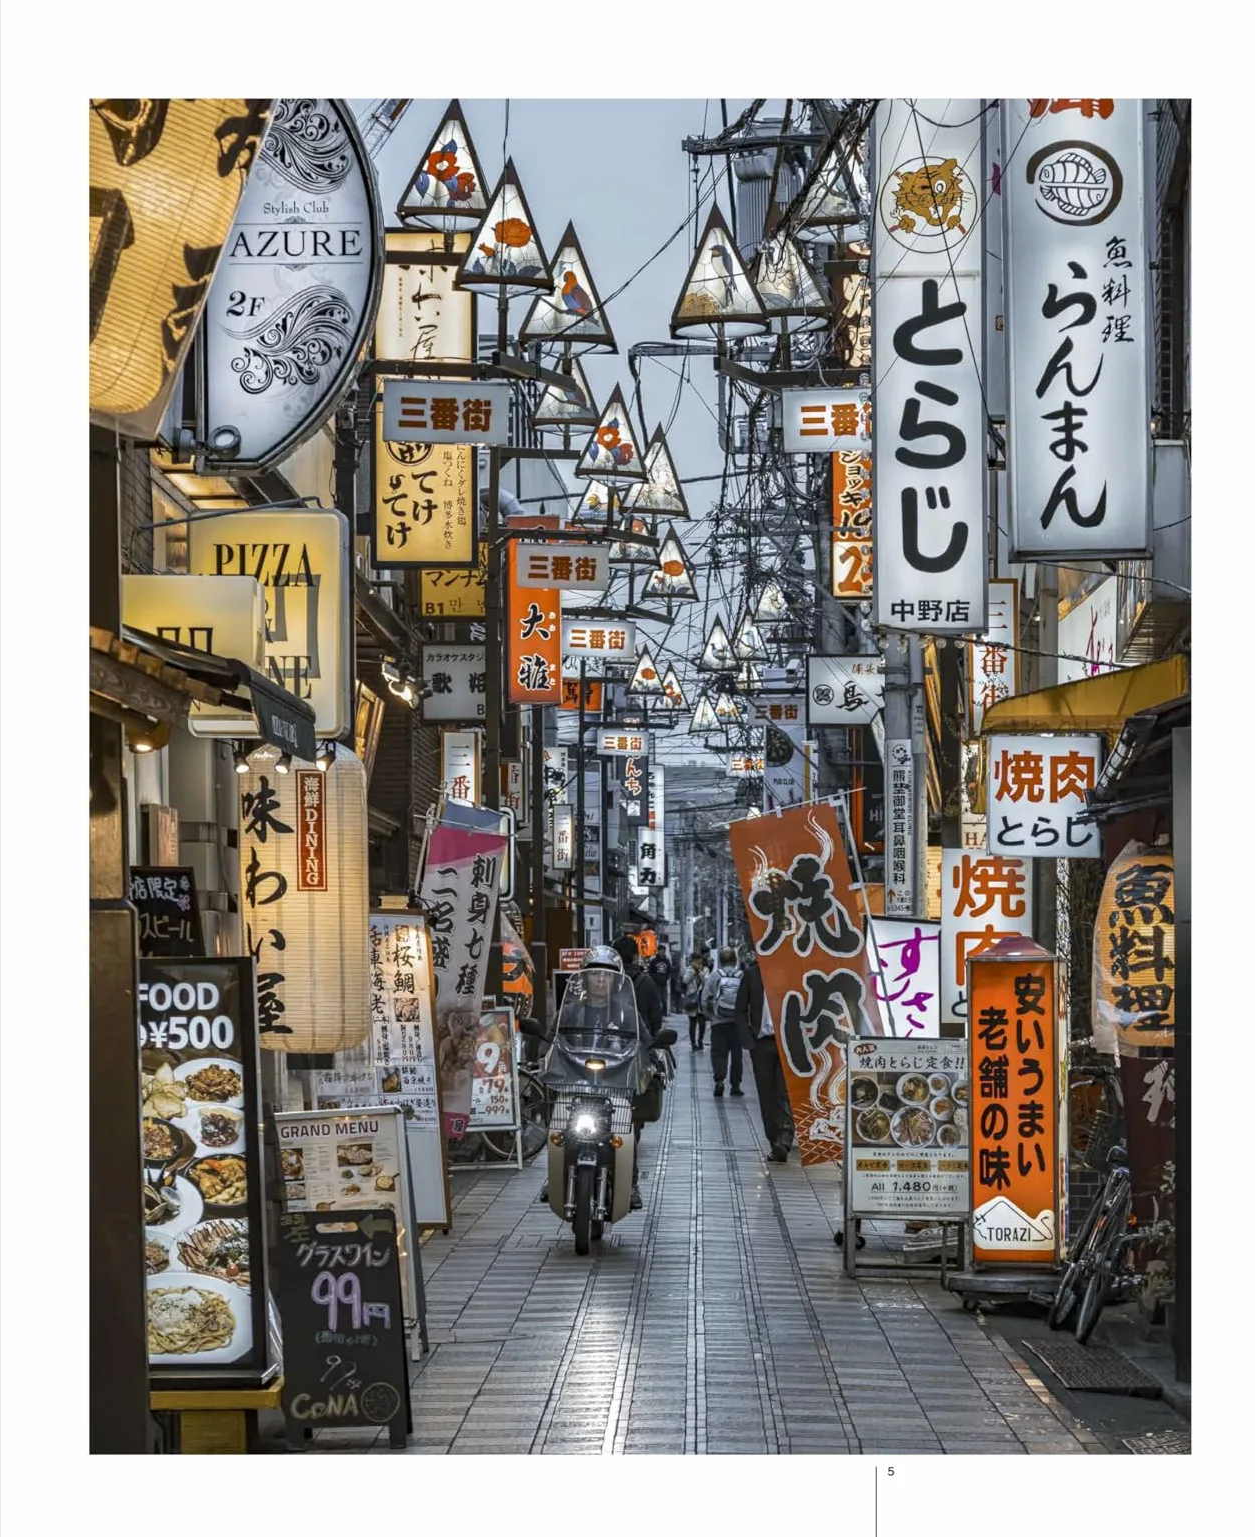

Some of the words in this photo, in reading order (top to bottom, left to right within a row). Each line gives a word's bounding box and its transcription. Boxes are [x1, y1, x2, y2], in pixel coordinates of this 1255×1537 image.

[263, 201, 300, 216] Stylish
[303, 201, 329, 214] Club
[229, 229, 364, 258] AZURE
[226, 290, 266, 317] 2F
[1101, 235, 1135, 344] 魚料理
[1035, 260, 1109, 530] らんまん
[398, 396, 492, 432] 三番街
[892, 278, 970, 574] とらじ
[411, 470, 438, 525] てけ
[381, 492, 413, 549] てけ
[213, 543, 318, 588] PIZZA
[527, 556, 597, 581] 三番街
[425, 602, 445, 615] B1
[891, 600, 971, 623] 中野店
[519, 603, 551, 692] 大雅
[569, 629, 626, 650] 三番街
[266, 655, 313, 700] NE
[755, 704, 799, 721] 三番街
[604, 736, 642, 751] 三番街
[447, 745, 472, 800] 三番
[625, 754, 644, 796] んち
[994, 750, 1096, 804] 焼肉
[996, 815, 1094, 847] とらじ
[129, 876, 179, 902] 店限定
[240, 776, 295, 1035] 味わい屋
[139, 912, 195, 943] スビール
[750, 855, 863, 1074] 焼肉
[1108, 863, 1175, 1032] 魚料理
[859, 1056, 966, 1070] 焼肉とらじ定食!!
[1014, 973, 1046, 1178] 安いうまい
[977, 1006, 1012, 1191] 老舗の味
[280, 1123, 331, 1139] GRAND
[335, 1120, 380, 1136] MENU
[986, 1227, 1033, 1243] TORAZI
[295, 1242, 391, 1268] グラスワイン
[310, 1271, 392, 1332] 99円
[887, 1466, 895, 1477] 5
